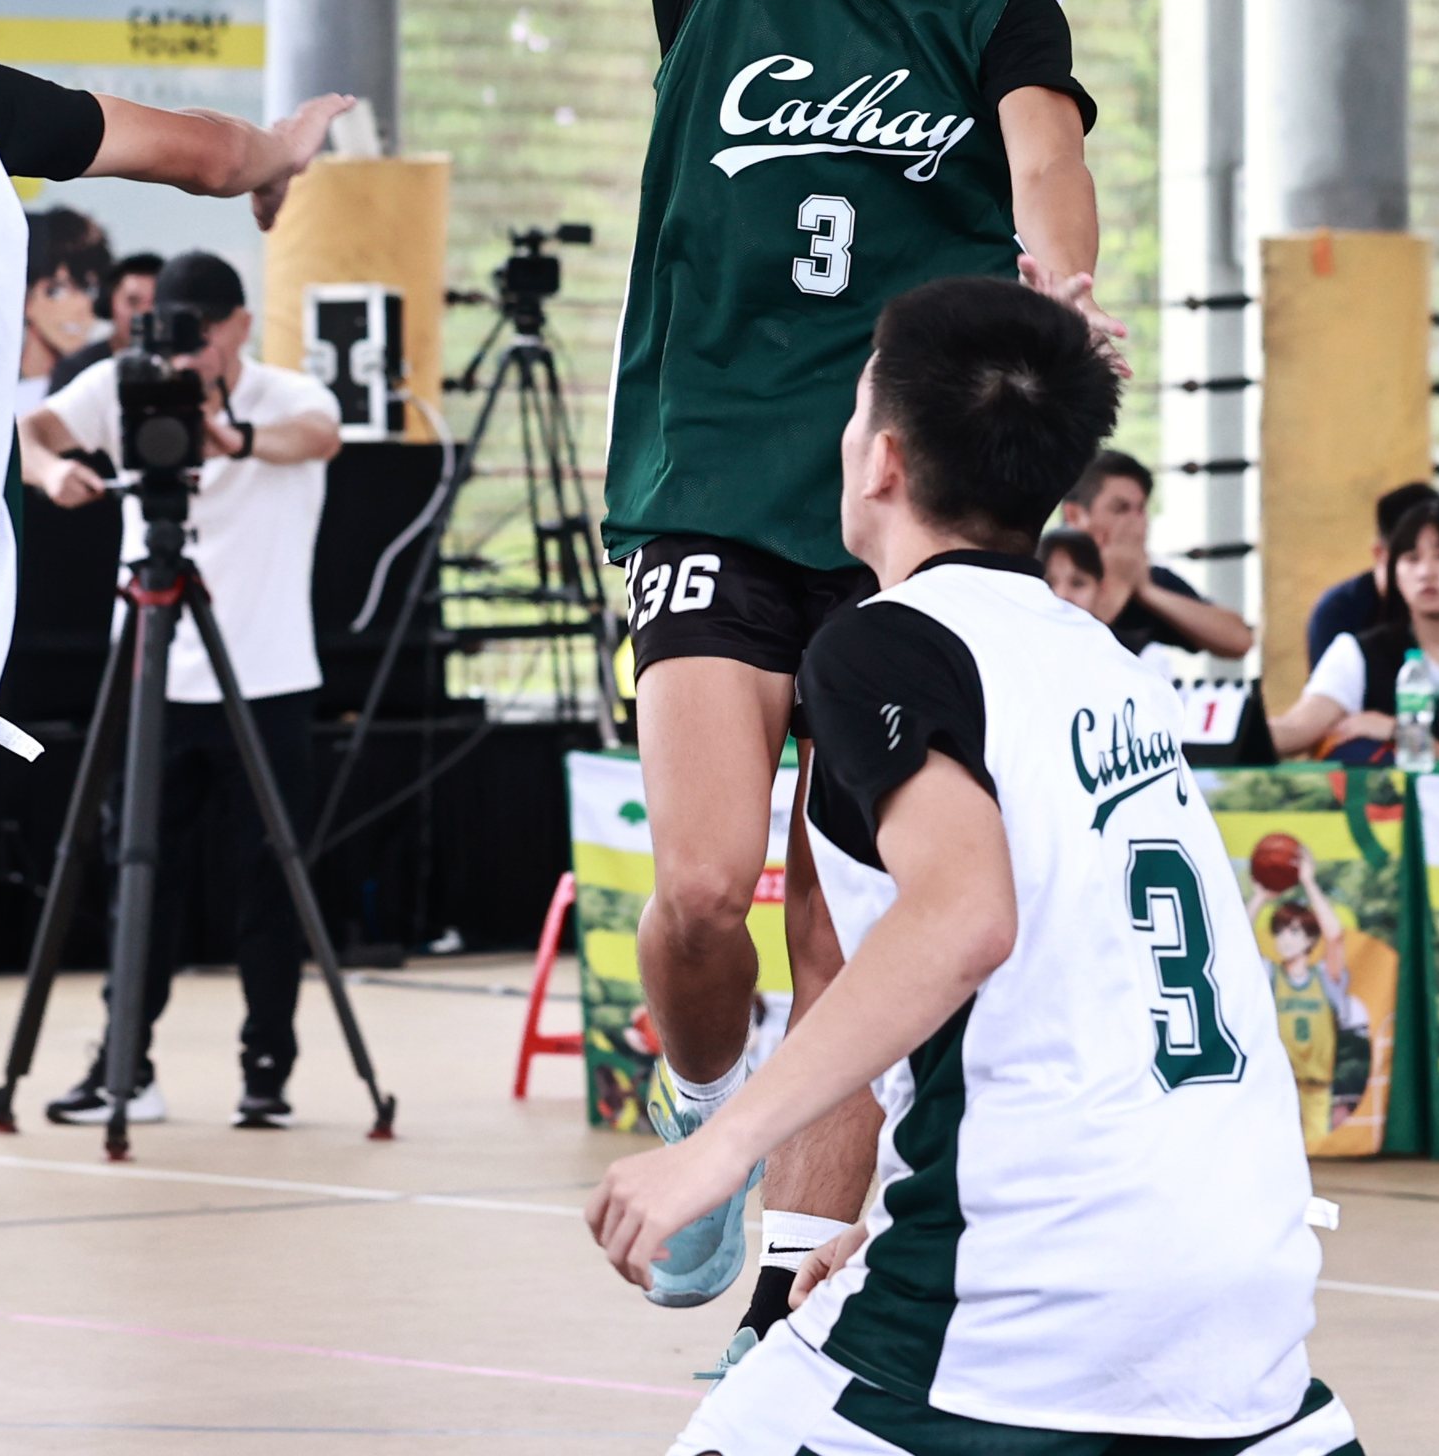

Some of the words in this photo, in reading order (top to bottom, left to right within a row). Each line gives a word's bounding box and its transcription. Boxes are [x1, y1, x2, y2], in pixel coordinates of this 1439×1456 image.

[710, 54, 976, 182] Cathay
[791, 194, 856, 298] 3
[1200, 700, 1219, 734] 1
[1125, 839, 1248, 1094] 3
